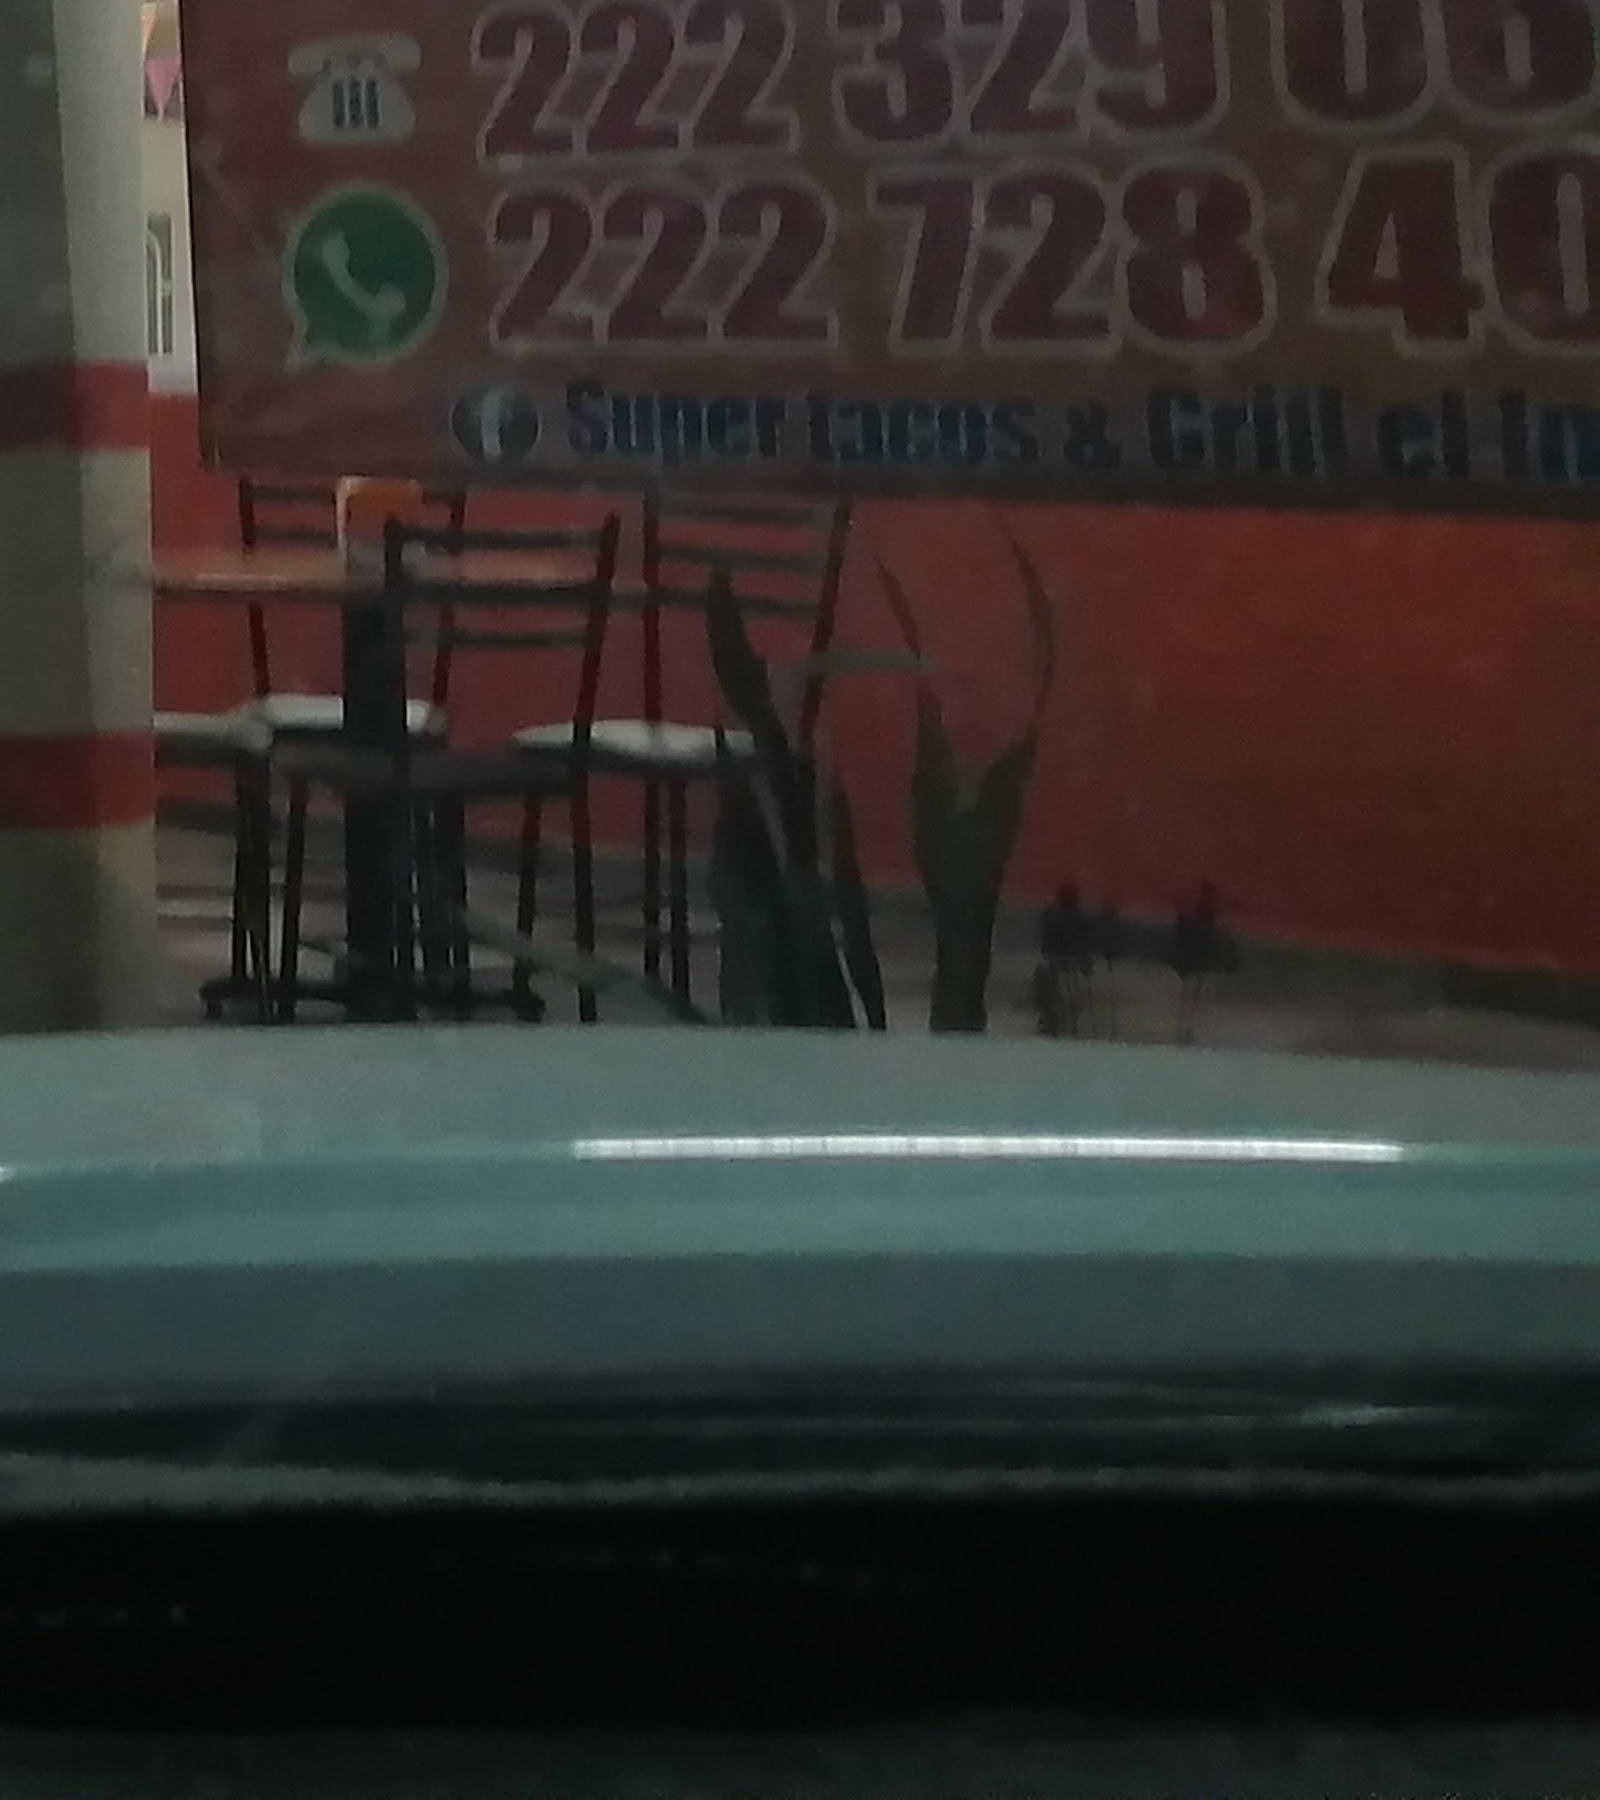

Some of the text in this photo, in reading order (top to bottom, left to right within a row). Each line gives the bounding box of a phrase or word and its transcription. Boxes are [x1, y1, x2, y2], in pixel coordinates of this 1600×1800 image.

[488, 138, 1600, 362] 222 728 40
[564, 376, 790, 468] Super
